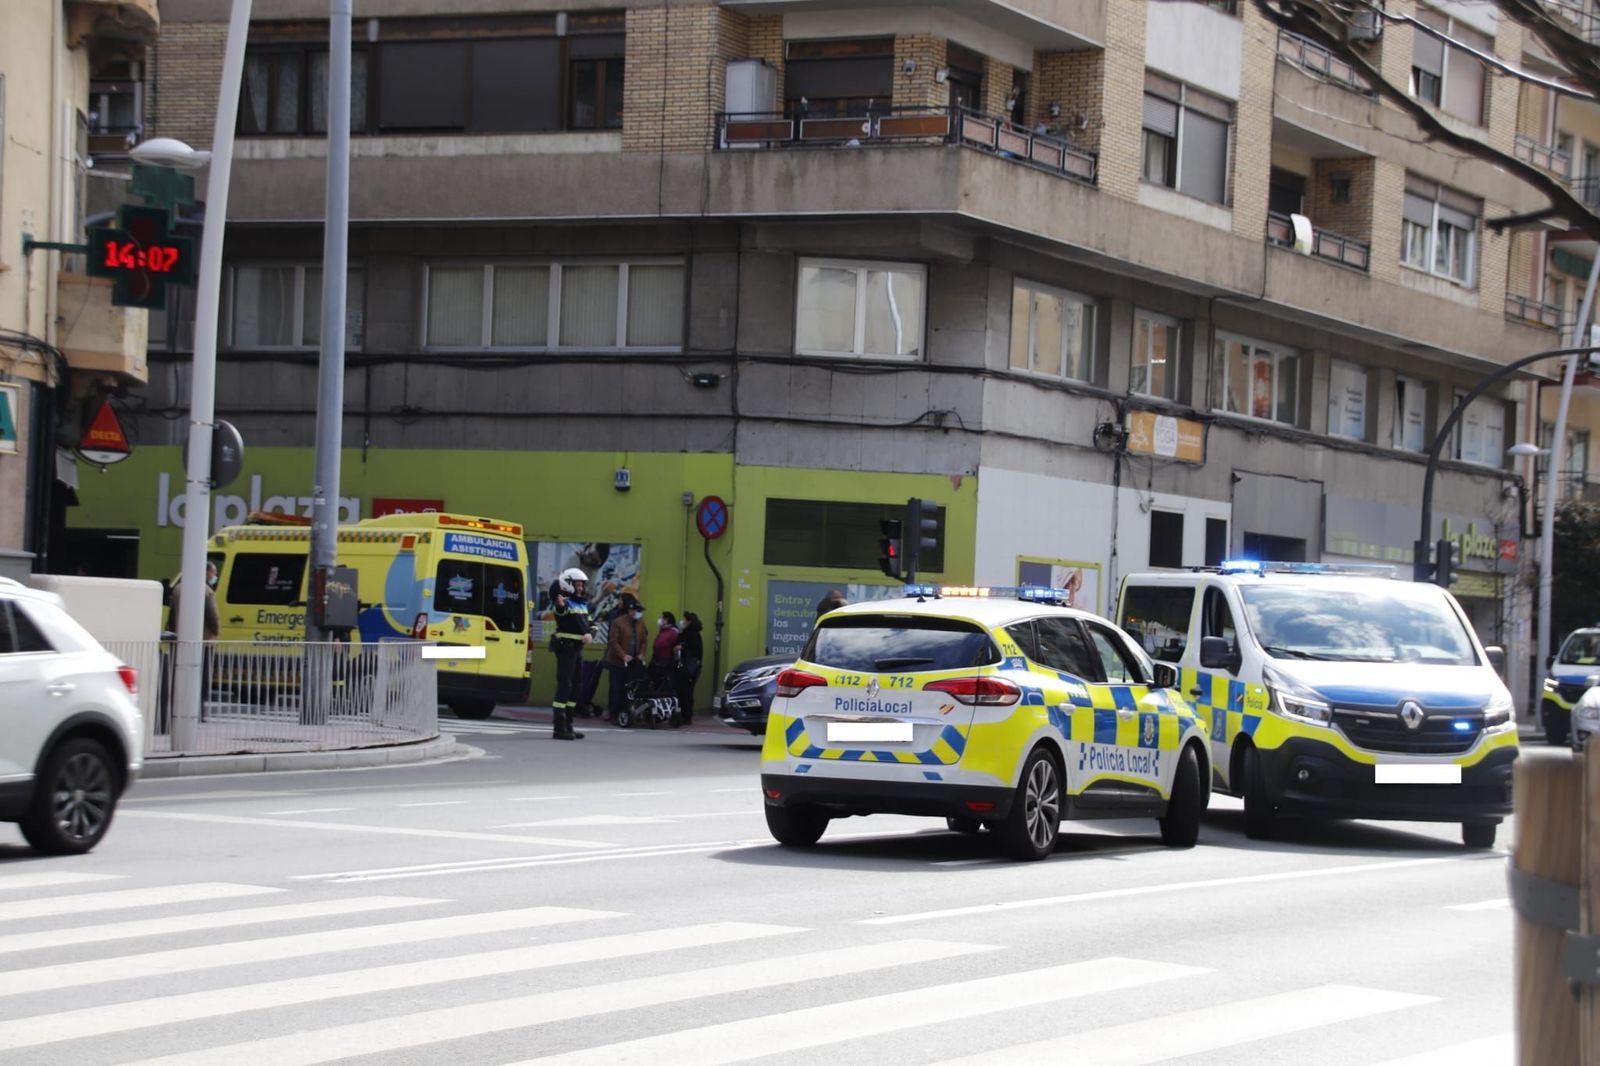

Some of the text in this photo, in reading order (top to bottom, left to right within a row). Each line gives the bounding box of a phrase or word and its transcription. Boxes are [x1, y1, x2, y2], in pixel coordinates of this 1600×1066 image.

[104, 241, 178, 272] 14:07
[91, 430, 121, 441] DELTA
[451, 534, 513, 550] AMBULANCIA
[451, 545, 513, 560] ASISTENCIAL
[774, 594, 803, 605] Entra
[774, 608, 817, 618] descubr
[257, 609, 304, 630] Emerge
[773, 619, 788, 628] los
[254, 632, 305, 647] Sanitari
[773, 633, 809, 643] ingredi
[1003, 644, 1017, 655] 712
[890, 676, 914, 688] 712
[1090, 746, 1151, 774] Policía Local
